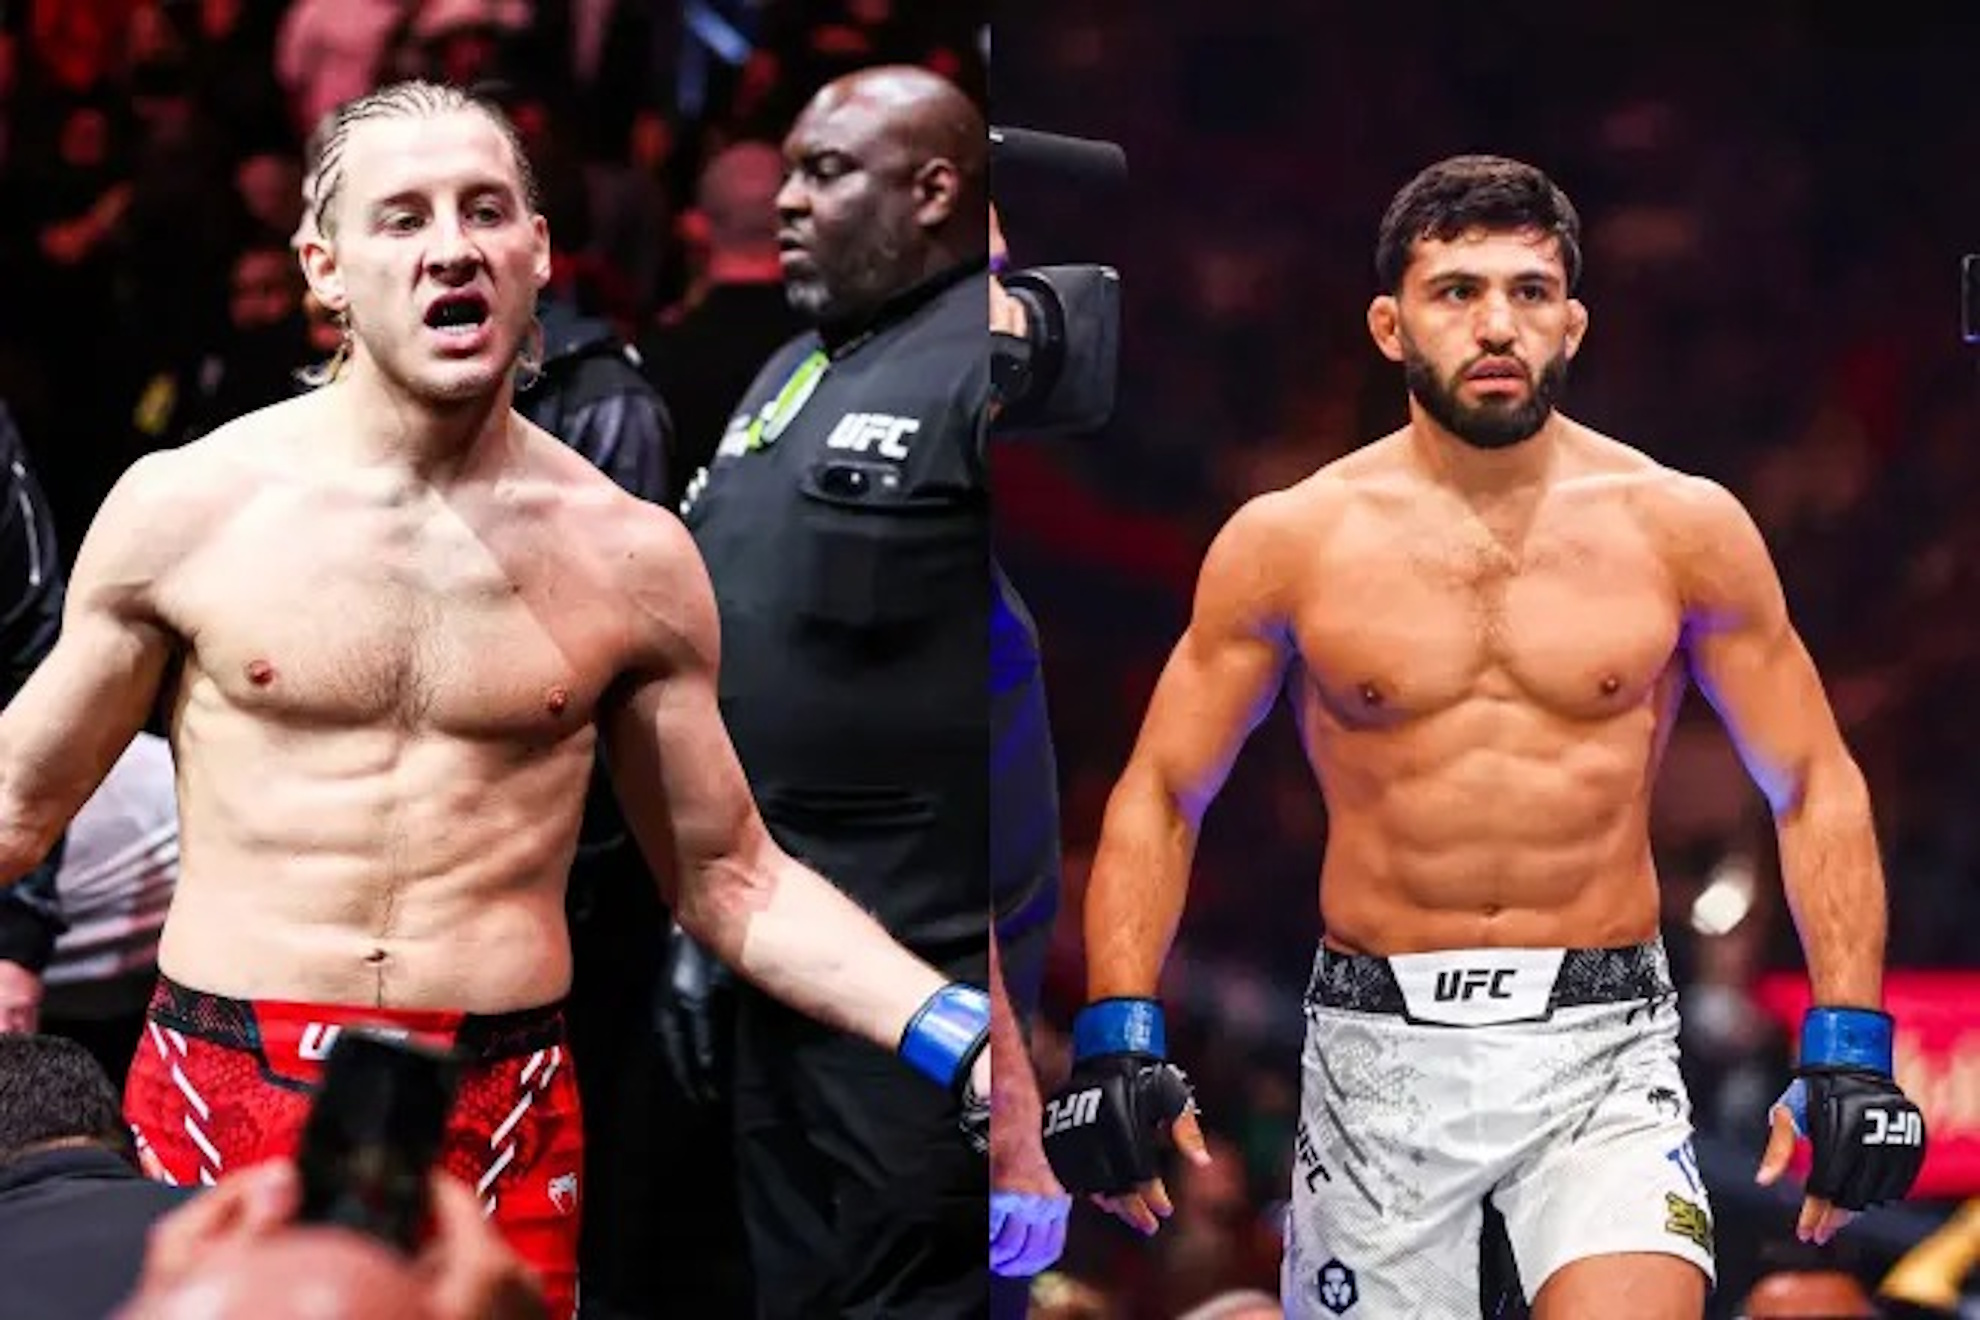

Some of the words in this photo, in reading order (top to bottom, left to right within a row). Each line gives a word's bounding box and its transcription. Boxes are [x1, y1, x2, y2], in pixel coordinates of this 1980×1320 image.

[826, 412, 920, 460] UFC
[1435, 969, 1518, 1002] UFC
[1043, 1088, 1103, 1138] UFC
[1861, 1109, 1922, 1147] UFC
